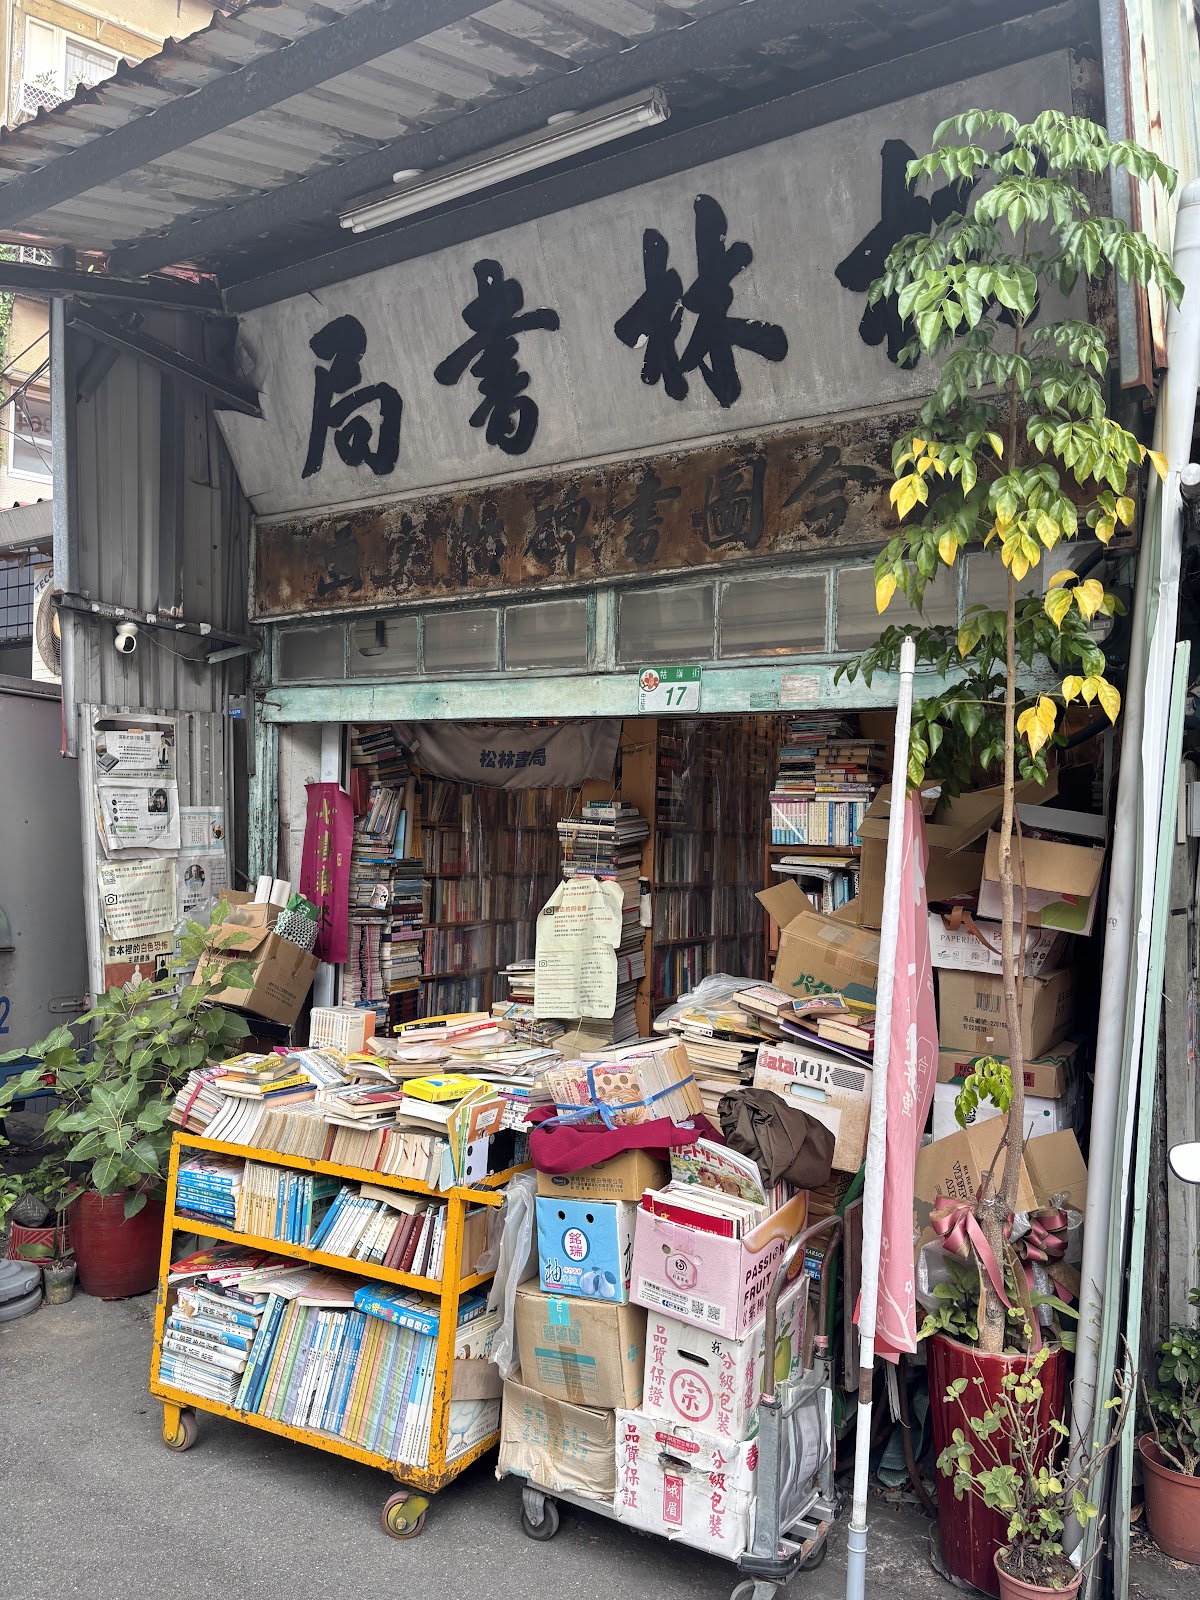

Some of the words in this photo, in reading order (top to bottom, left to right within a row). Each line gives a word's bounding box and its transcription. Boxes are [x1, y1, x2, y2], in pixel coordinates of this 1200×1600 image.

[666, 686, 688, 706] 17
[479, 747, 547, 769] 松林書局
[108, 940, 169, 957] 書本裡的白色恐怖
[568, 1231, 583, 1258] 銘瑞
[545, 1258, 562, 1282] 柚
[743, 1271, 772, 1305] FRUIT
[648, 1324, 668, 1408] 品質保證
[680, 1377, 703, 1412] 宗
[716, 1351, 737, 1437] 分級包裝
[621, 1424, 641, 1509] 品質保証
[708, 1449, 728, 1540] 分級包裝
